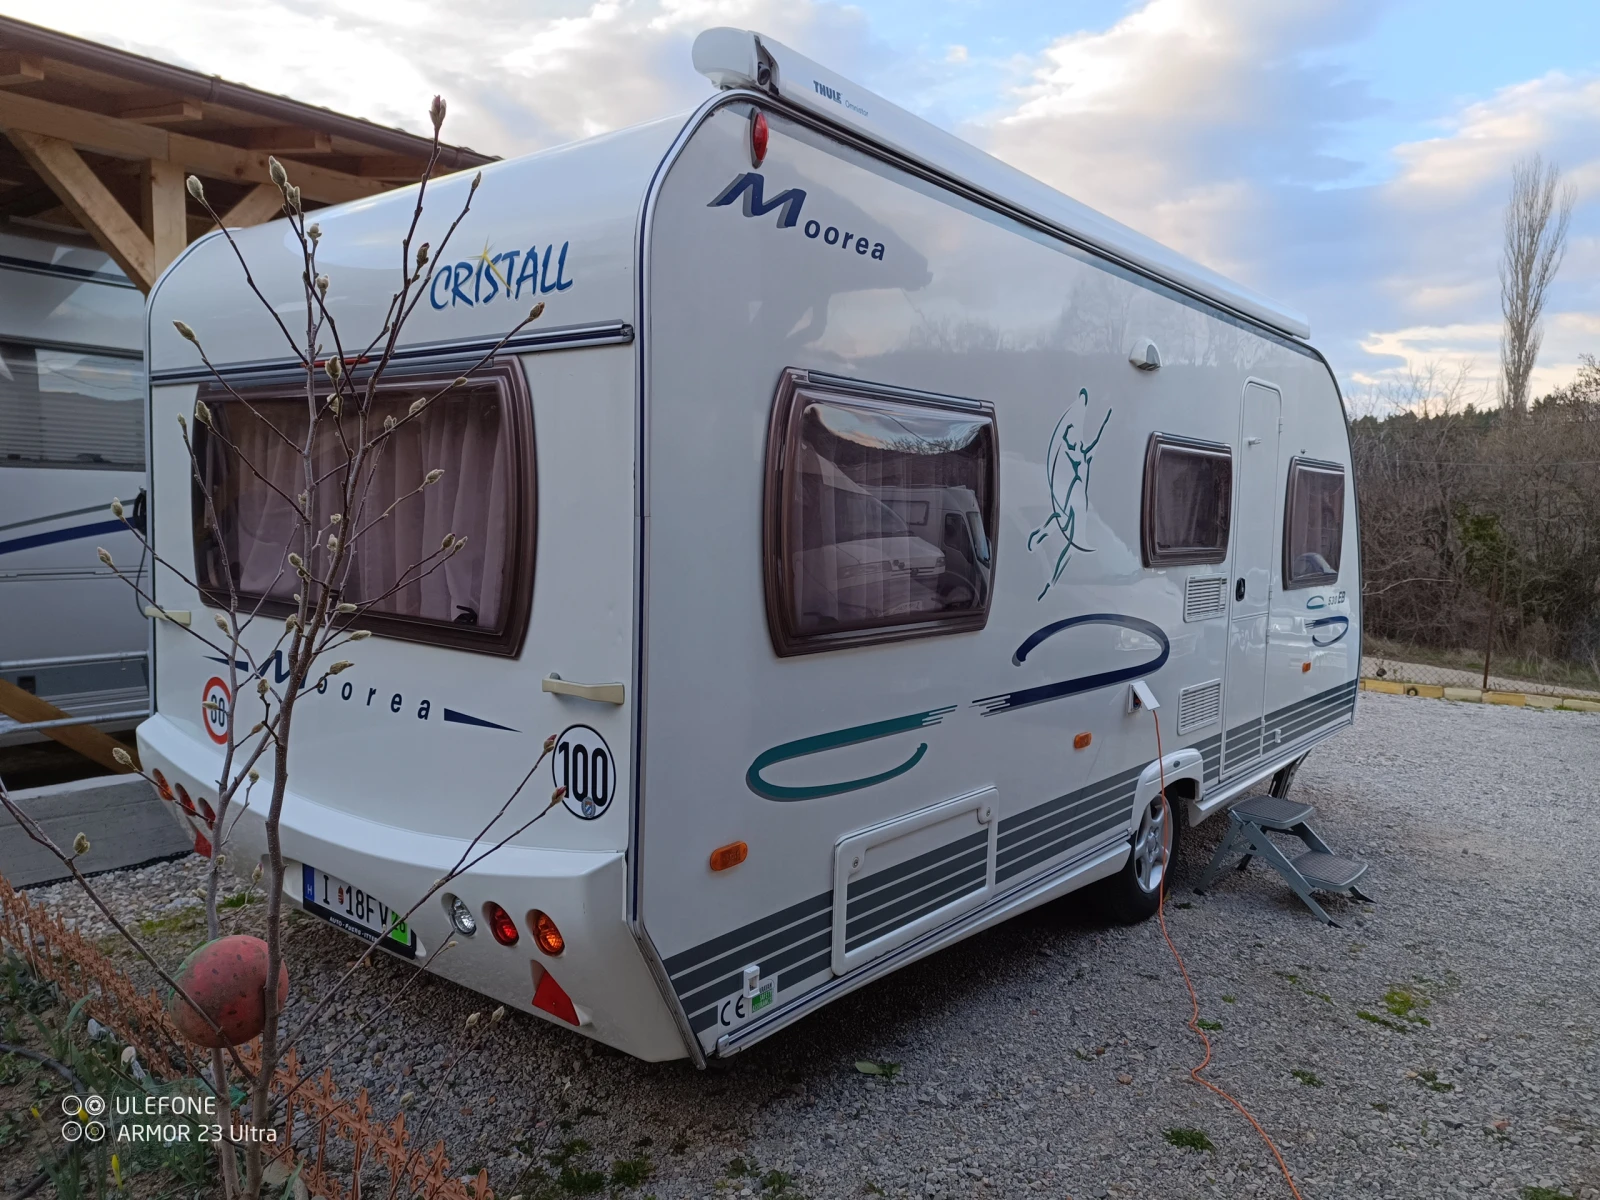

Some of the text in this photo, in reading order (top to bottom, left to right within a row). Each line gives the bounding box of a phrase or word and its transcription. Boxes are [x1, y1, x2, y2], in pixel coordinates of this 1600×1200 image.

[813, 80, 842, 104] THULE
[706, 172, 885, 261] Moorea
[430, 240, 573, 310] CRISTALL
[558, 741, 608, 807] 100
